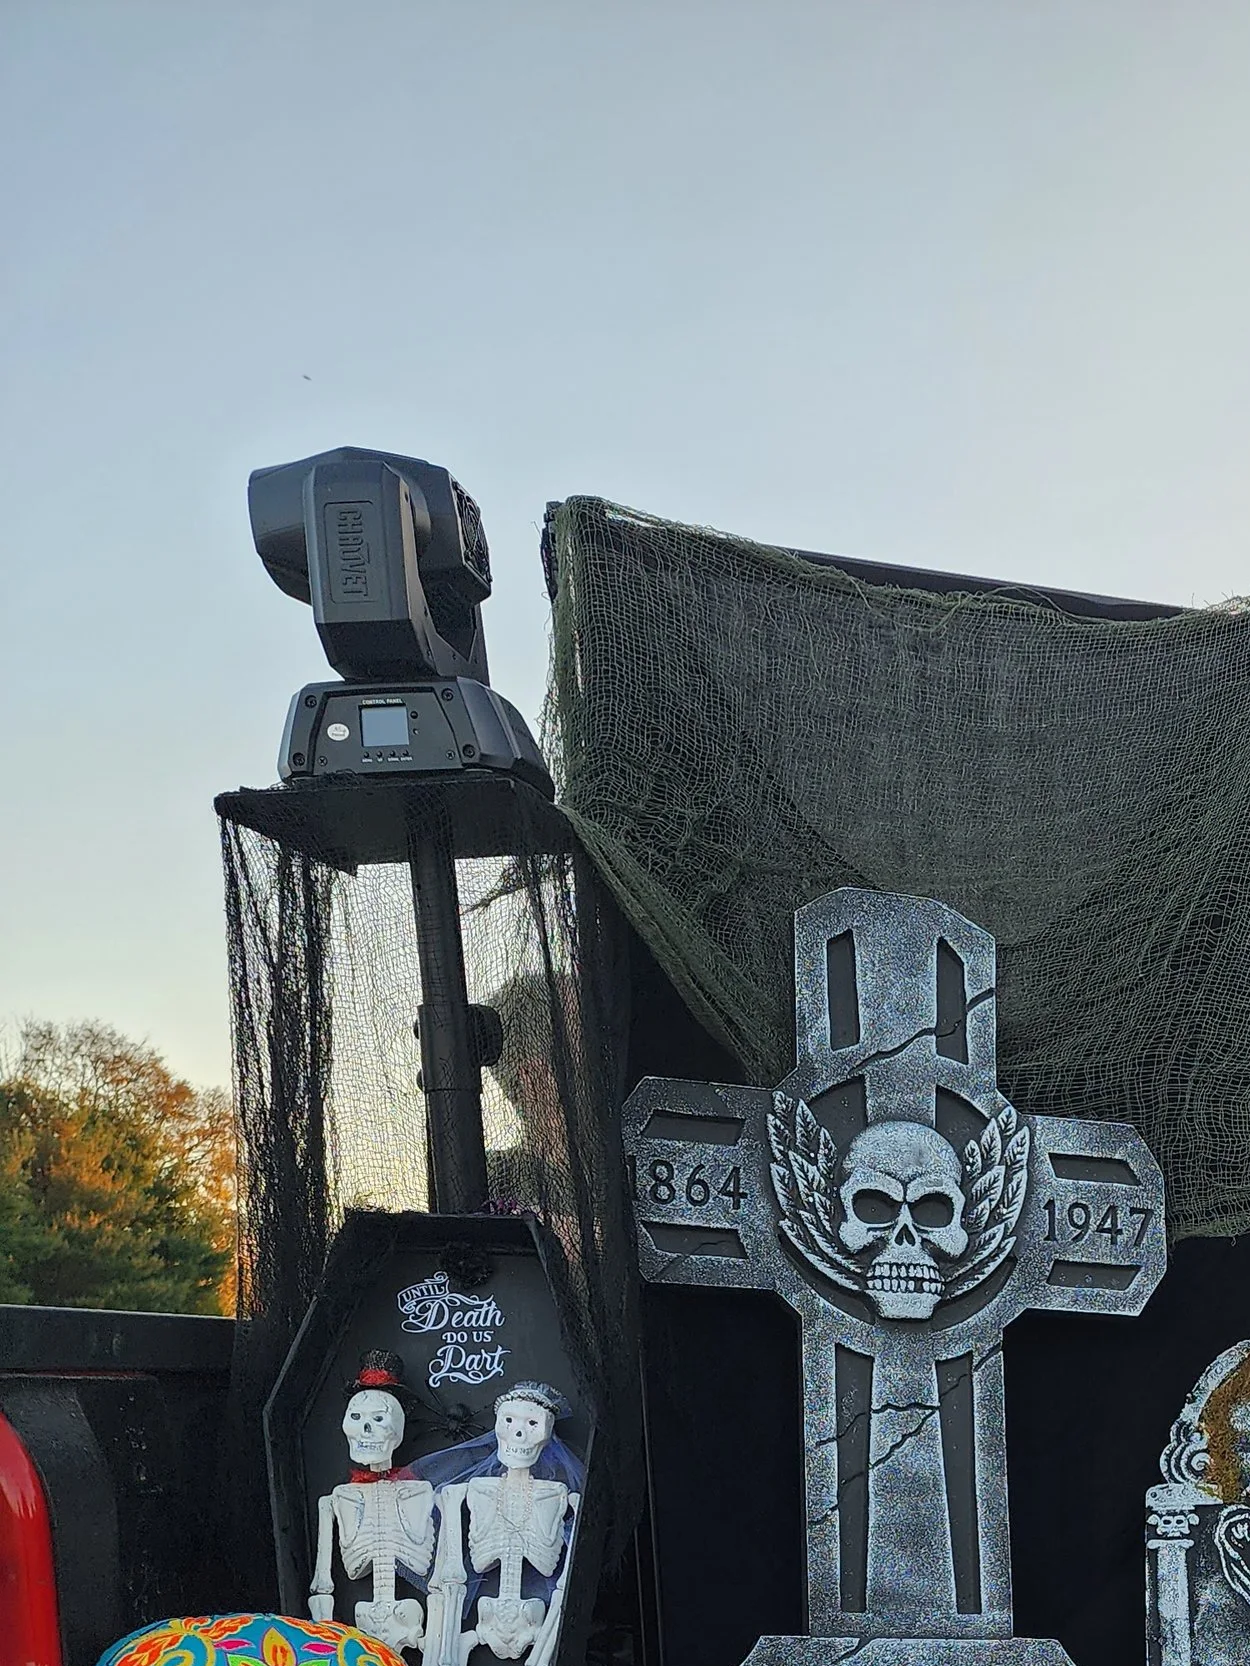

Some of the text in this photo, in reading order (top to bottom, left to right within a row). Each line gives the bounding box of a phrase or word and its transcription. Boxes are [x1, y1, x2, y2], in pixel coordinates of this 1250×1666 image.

[337, 509, 370, 597] CHAUVET
[1042, 1197, 1154, 1247] 1947
[401, 1284, 446, 1303] UNTIL
[401, 1293, 506, 1333] Death
[442, 1330, 495, 1343] DO US
[428, 1344, 512, 1388] Part
